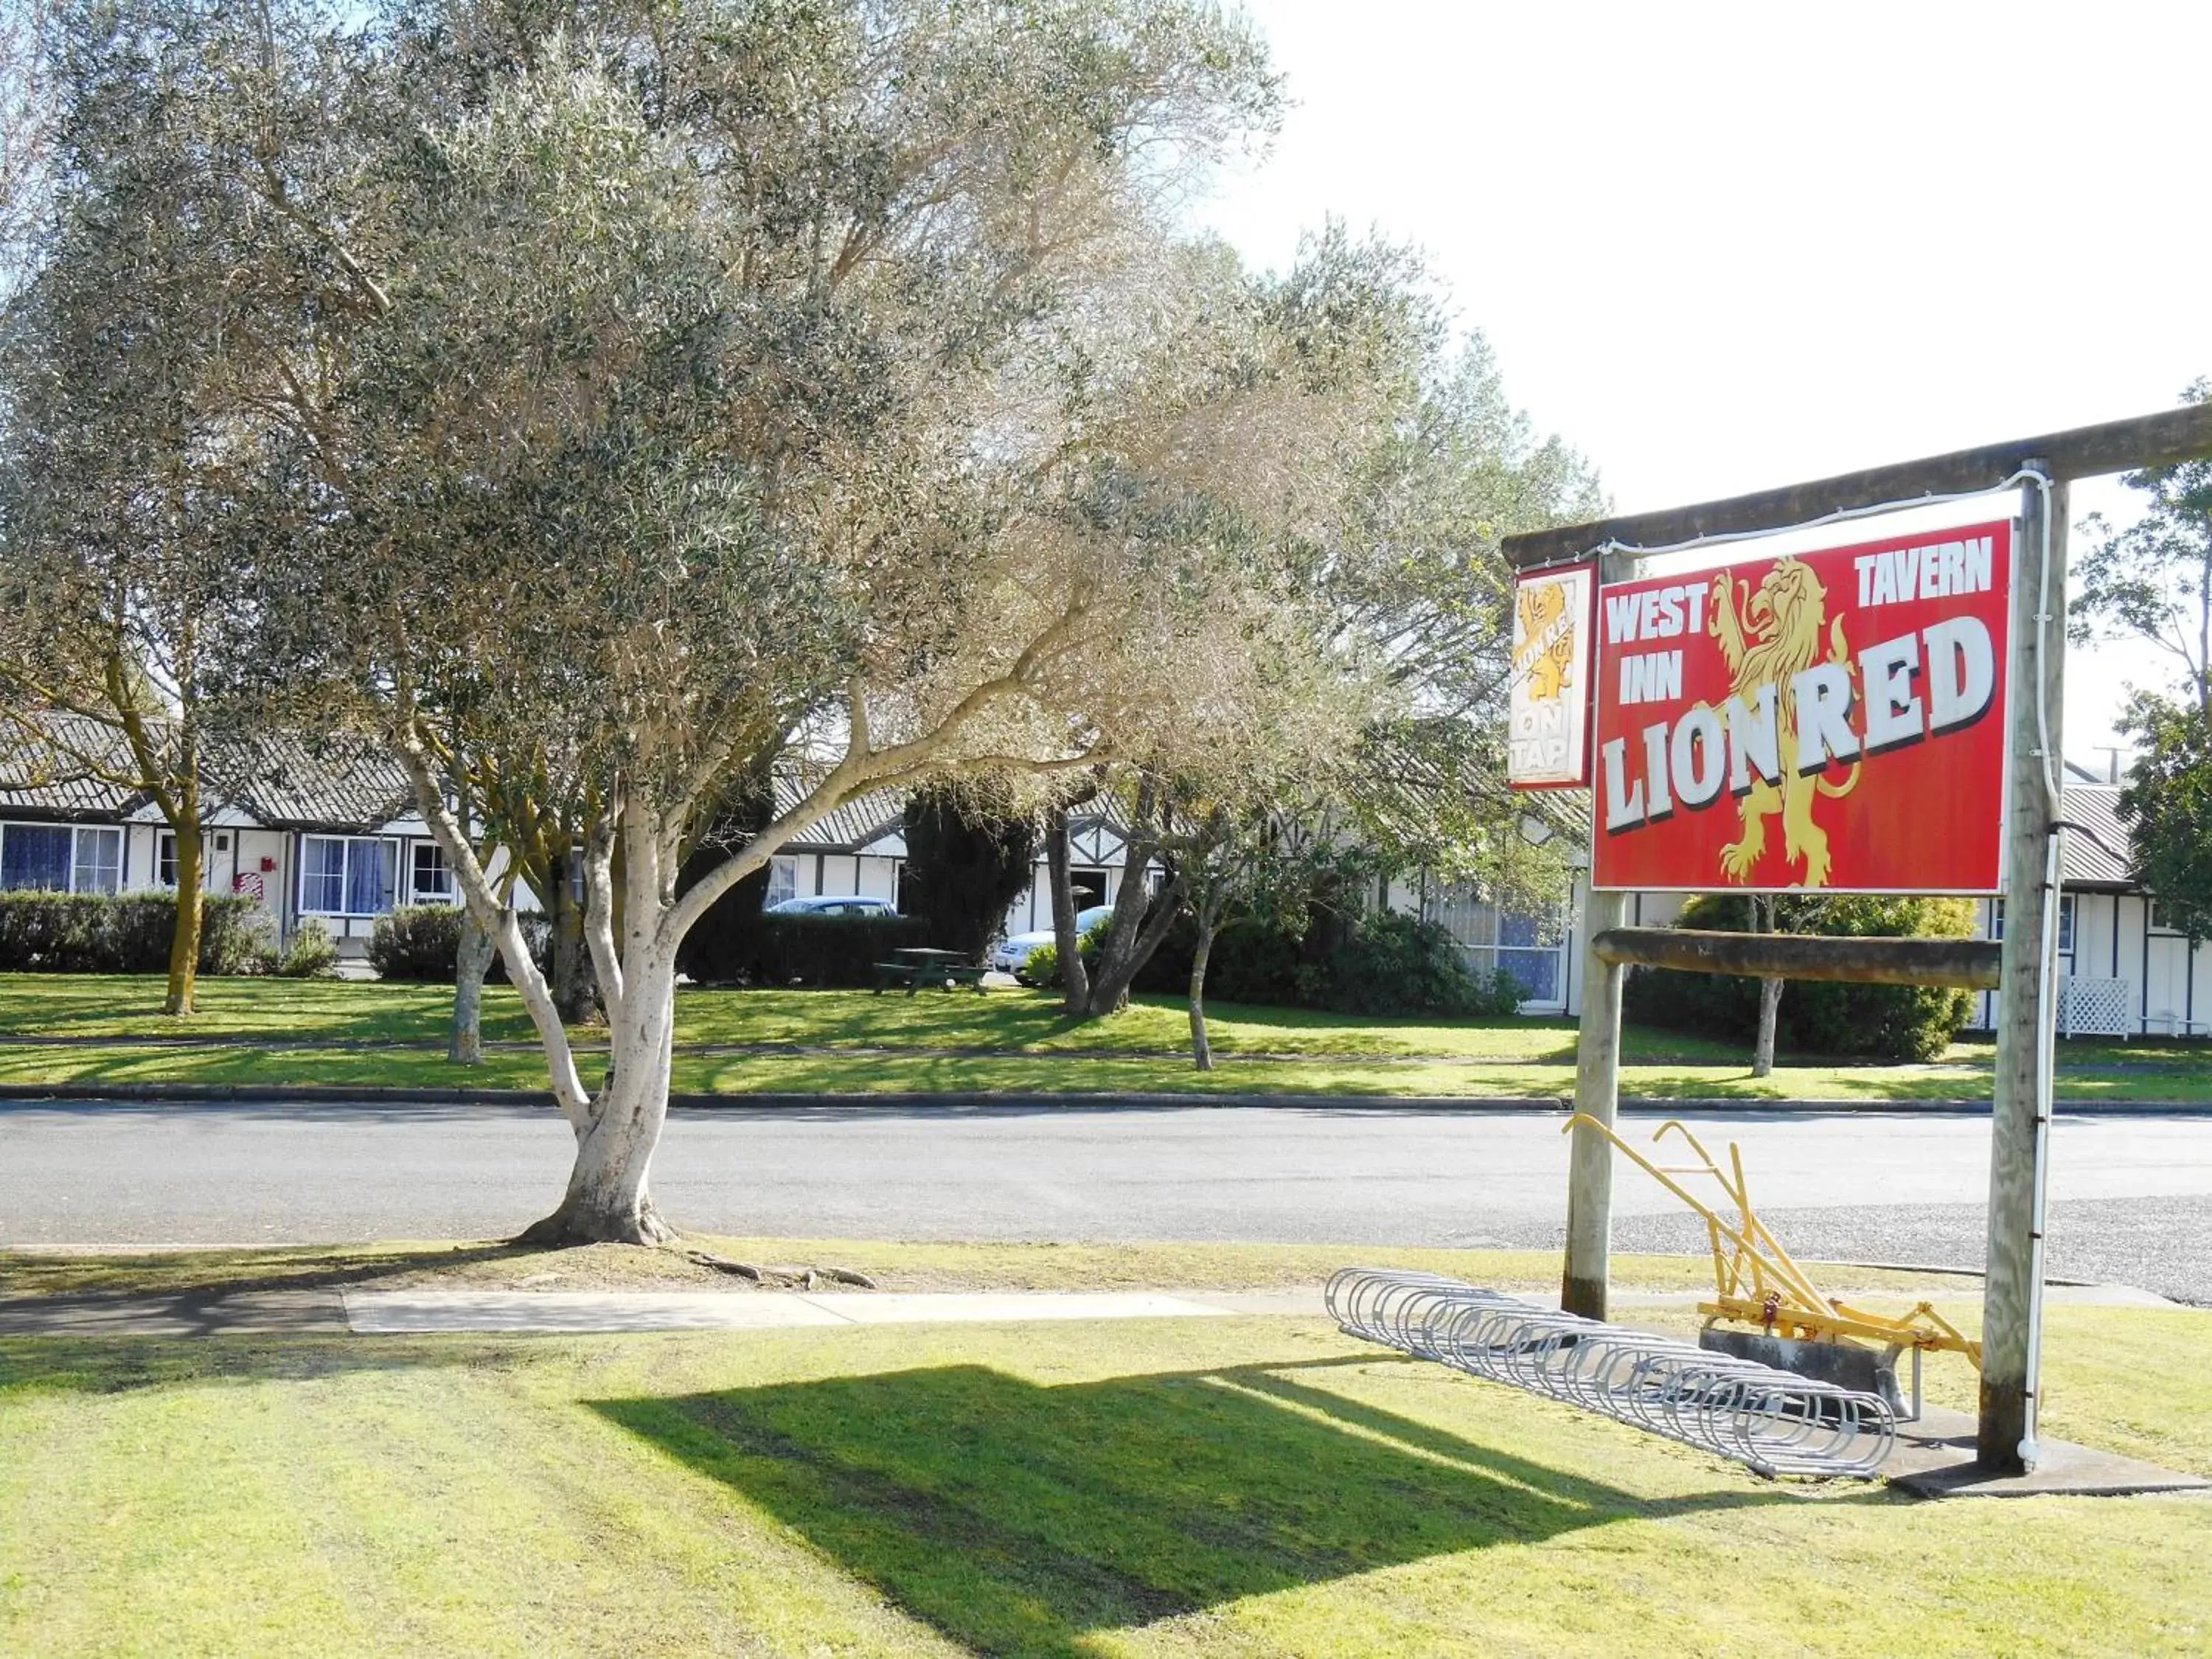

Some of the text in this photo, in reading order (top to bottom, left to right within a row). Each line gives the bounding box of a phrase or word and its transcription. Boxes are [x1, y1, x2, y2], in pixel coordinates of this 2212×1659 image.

[1854, 537, 1992, 607] TAVERN
[1606, 582, 1708, 644] WEST
[1619, 650, 1683, 705] INN
[1516, 705, 1563, 737] ON
[1600, 616, 1995, 835] LION RED
[1510, 738, 1568, 770] TAP
